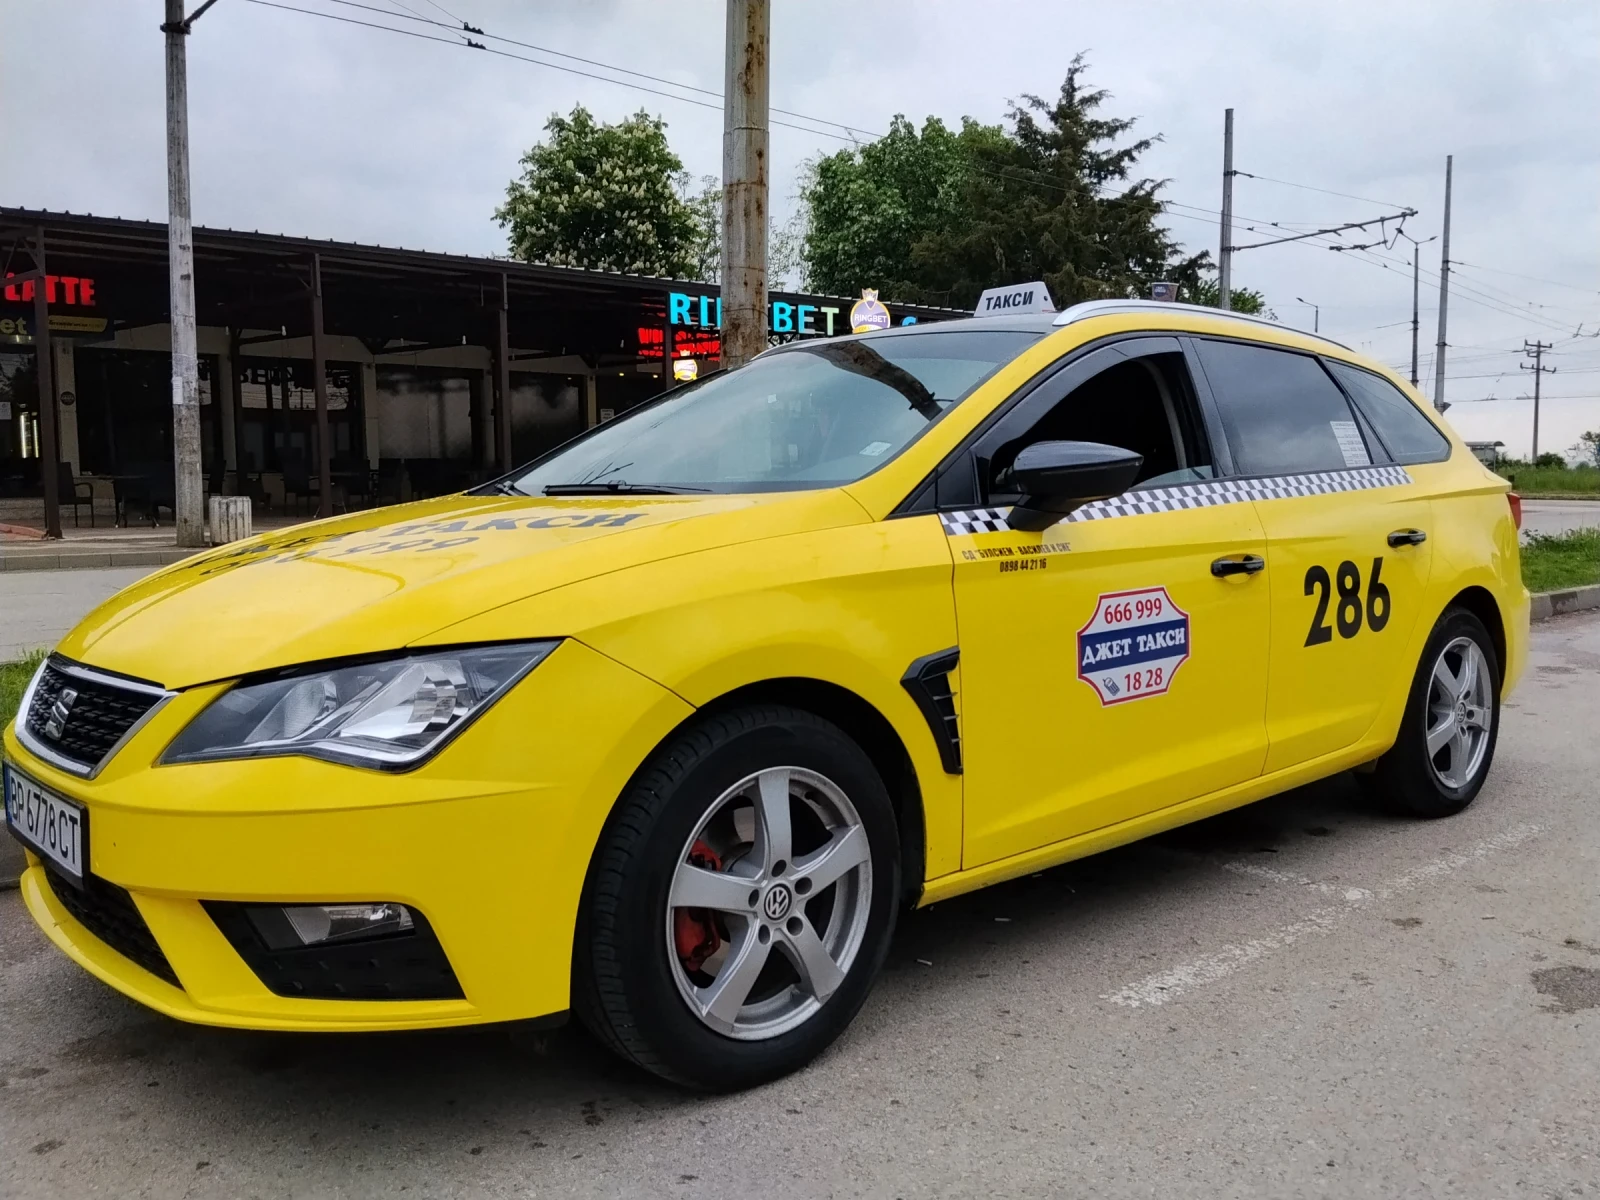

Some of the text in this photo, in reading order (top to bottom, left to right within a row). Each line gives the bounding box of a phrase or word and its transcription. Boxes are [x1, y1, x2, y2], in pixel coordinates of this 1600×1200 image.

[669, 292, 839, 336] RIBET
[984, 290, 1034, 311] ТАКСИ
[854, 313, 887, 323] RINGBET
[1000, 558, 1047, 572] 0898 44 21 16
[1104, 597, 1162, 624] 666 999
[1303, 556, 1391, 648] 286
[1081, 627, 1186, 666] ДЖЕТ ТАКСИ
